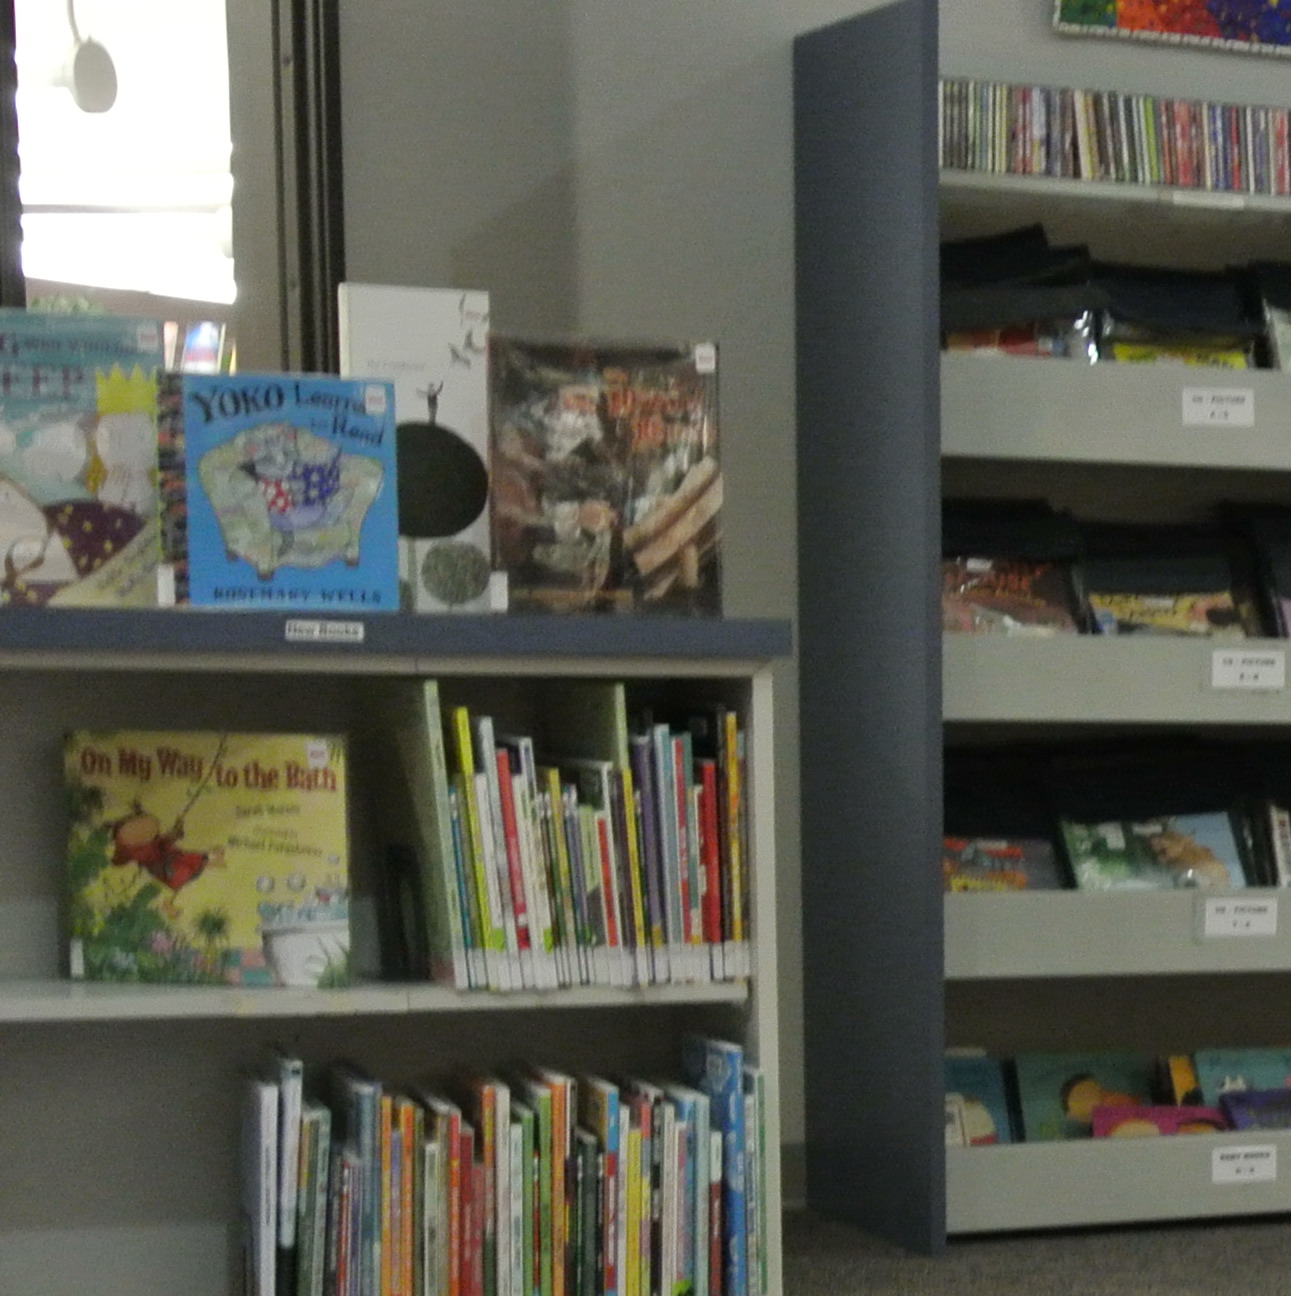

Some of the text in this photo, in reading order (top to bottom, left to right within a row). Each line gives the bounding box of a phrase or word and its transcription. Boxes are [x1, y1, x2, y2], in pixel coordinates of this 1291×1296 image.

[189, 383, 285, 424] YOKO
[80, 746, 338, 792] On My Way to the Bath
